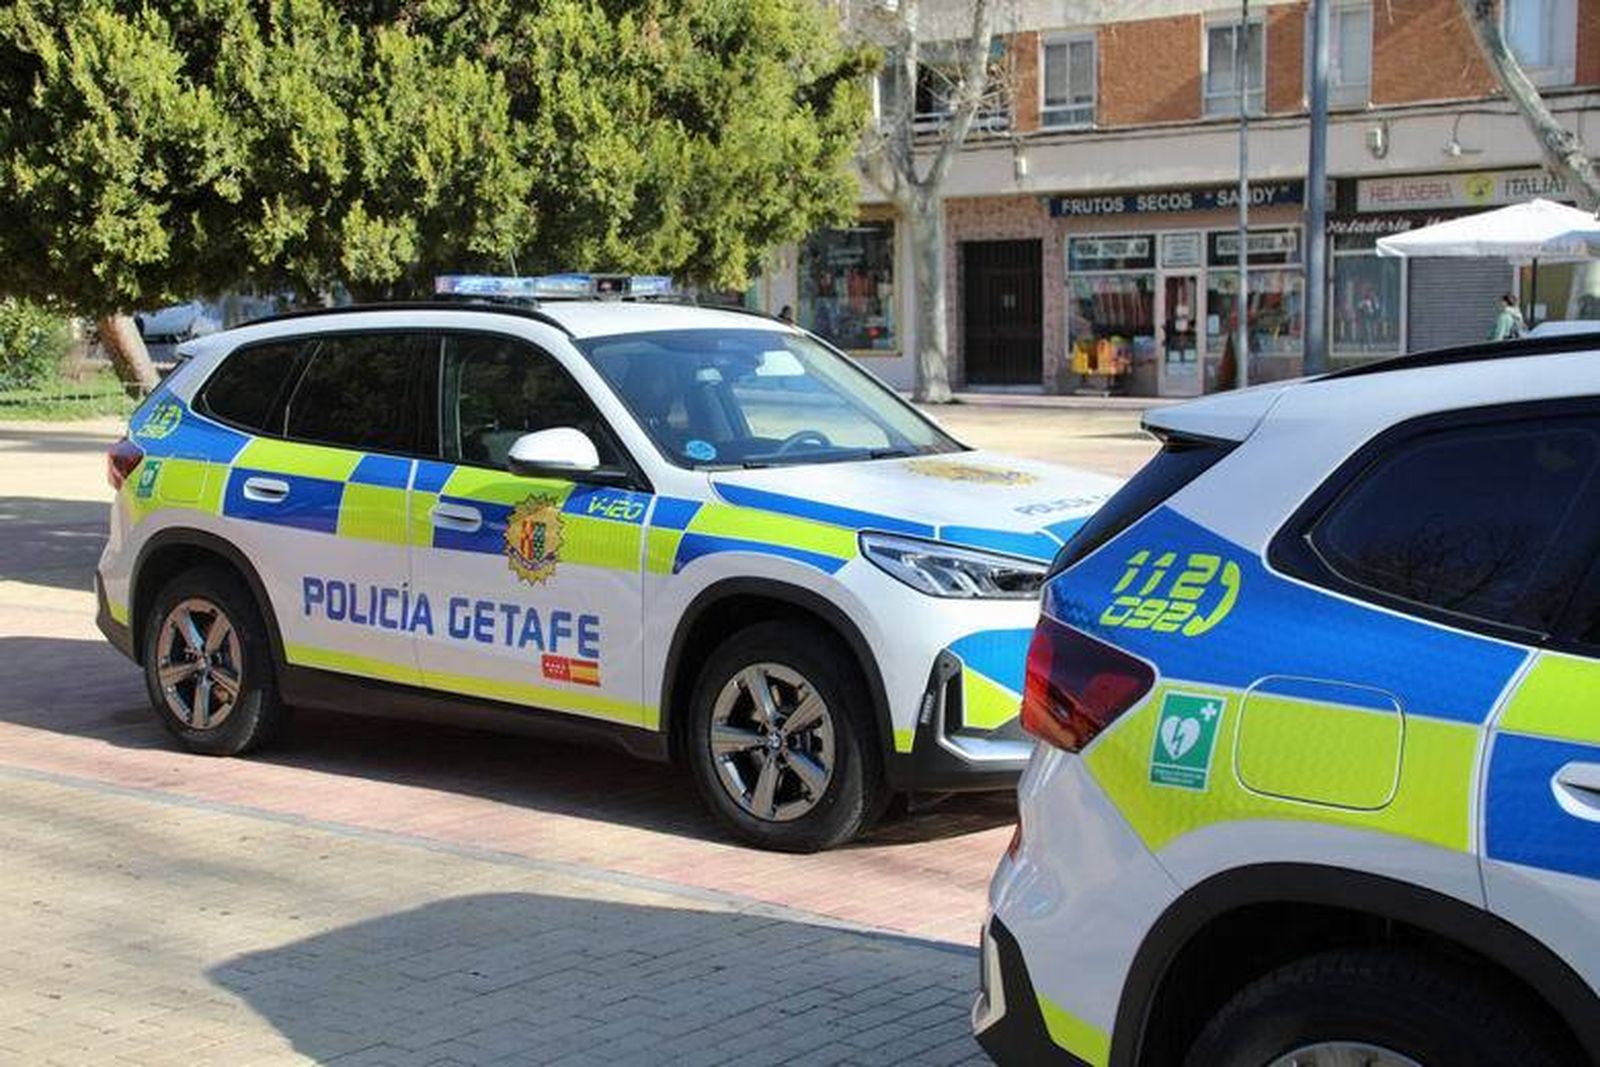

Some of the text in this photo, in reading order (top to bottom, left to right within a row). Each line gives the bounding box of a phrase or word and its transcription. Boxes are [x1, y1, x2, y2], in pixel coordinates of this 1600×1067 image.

[1061, 195, 1126, 216] FRUTOS
[1136, 192, 1194, 212] SECOS
[1368, 181, 1454, 203] HELADERIA
[1112, 550, 1222, 601] 112
[302, 576, 600, 659] POLICÍA GETAFE
[1099, 596, 1198, 633] 092
